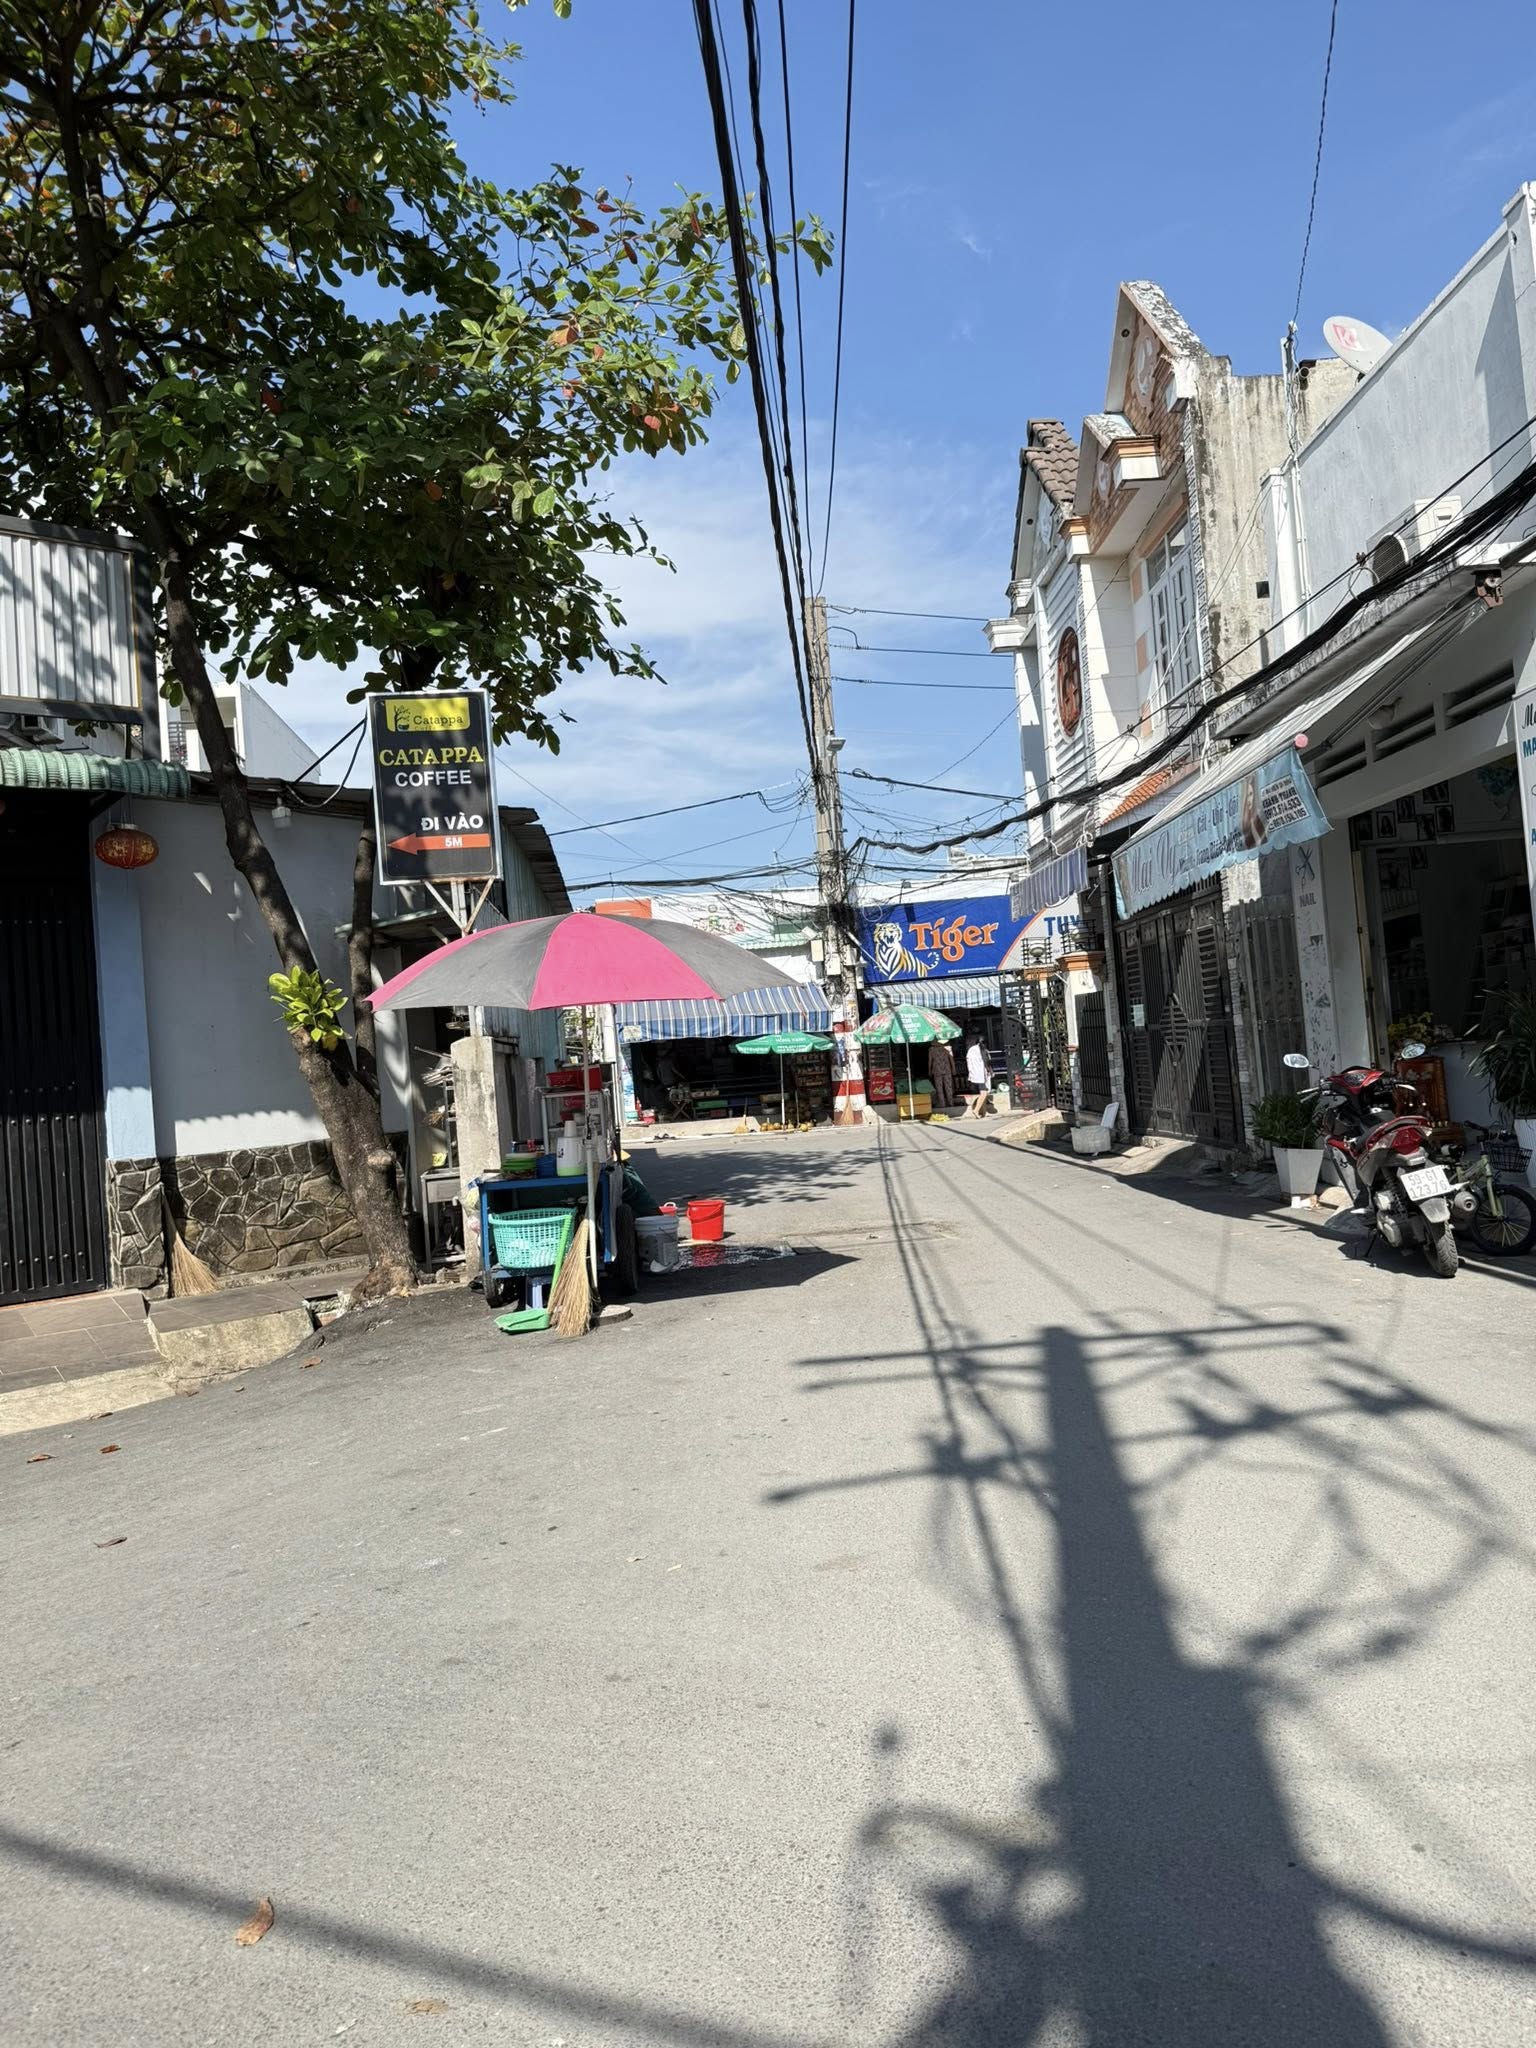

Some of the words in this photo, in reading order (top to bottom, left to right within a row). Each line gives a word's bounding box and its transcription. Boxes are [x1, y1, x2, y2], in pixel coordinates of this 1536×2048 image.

[413, 715, 464, 727] Catappa
[380, 746, 485, 766] CATAPPA
[395, 769, 472, 787] COFFEE
[421, 816, 440, 831] ĐI
[443, 811, 484, 831] VÀO
[445, 836, 463, 848] 5M
[1299, 892, 1317, 908] NAIL
[908, 914, 999, 962] Tiger
[1408, 1169, 1438, 1186] 59-G1
